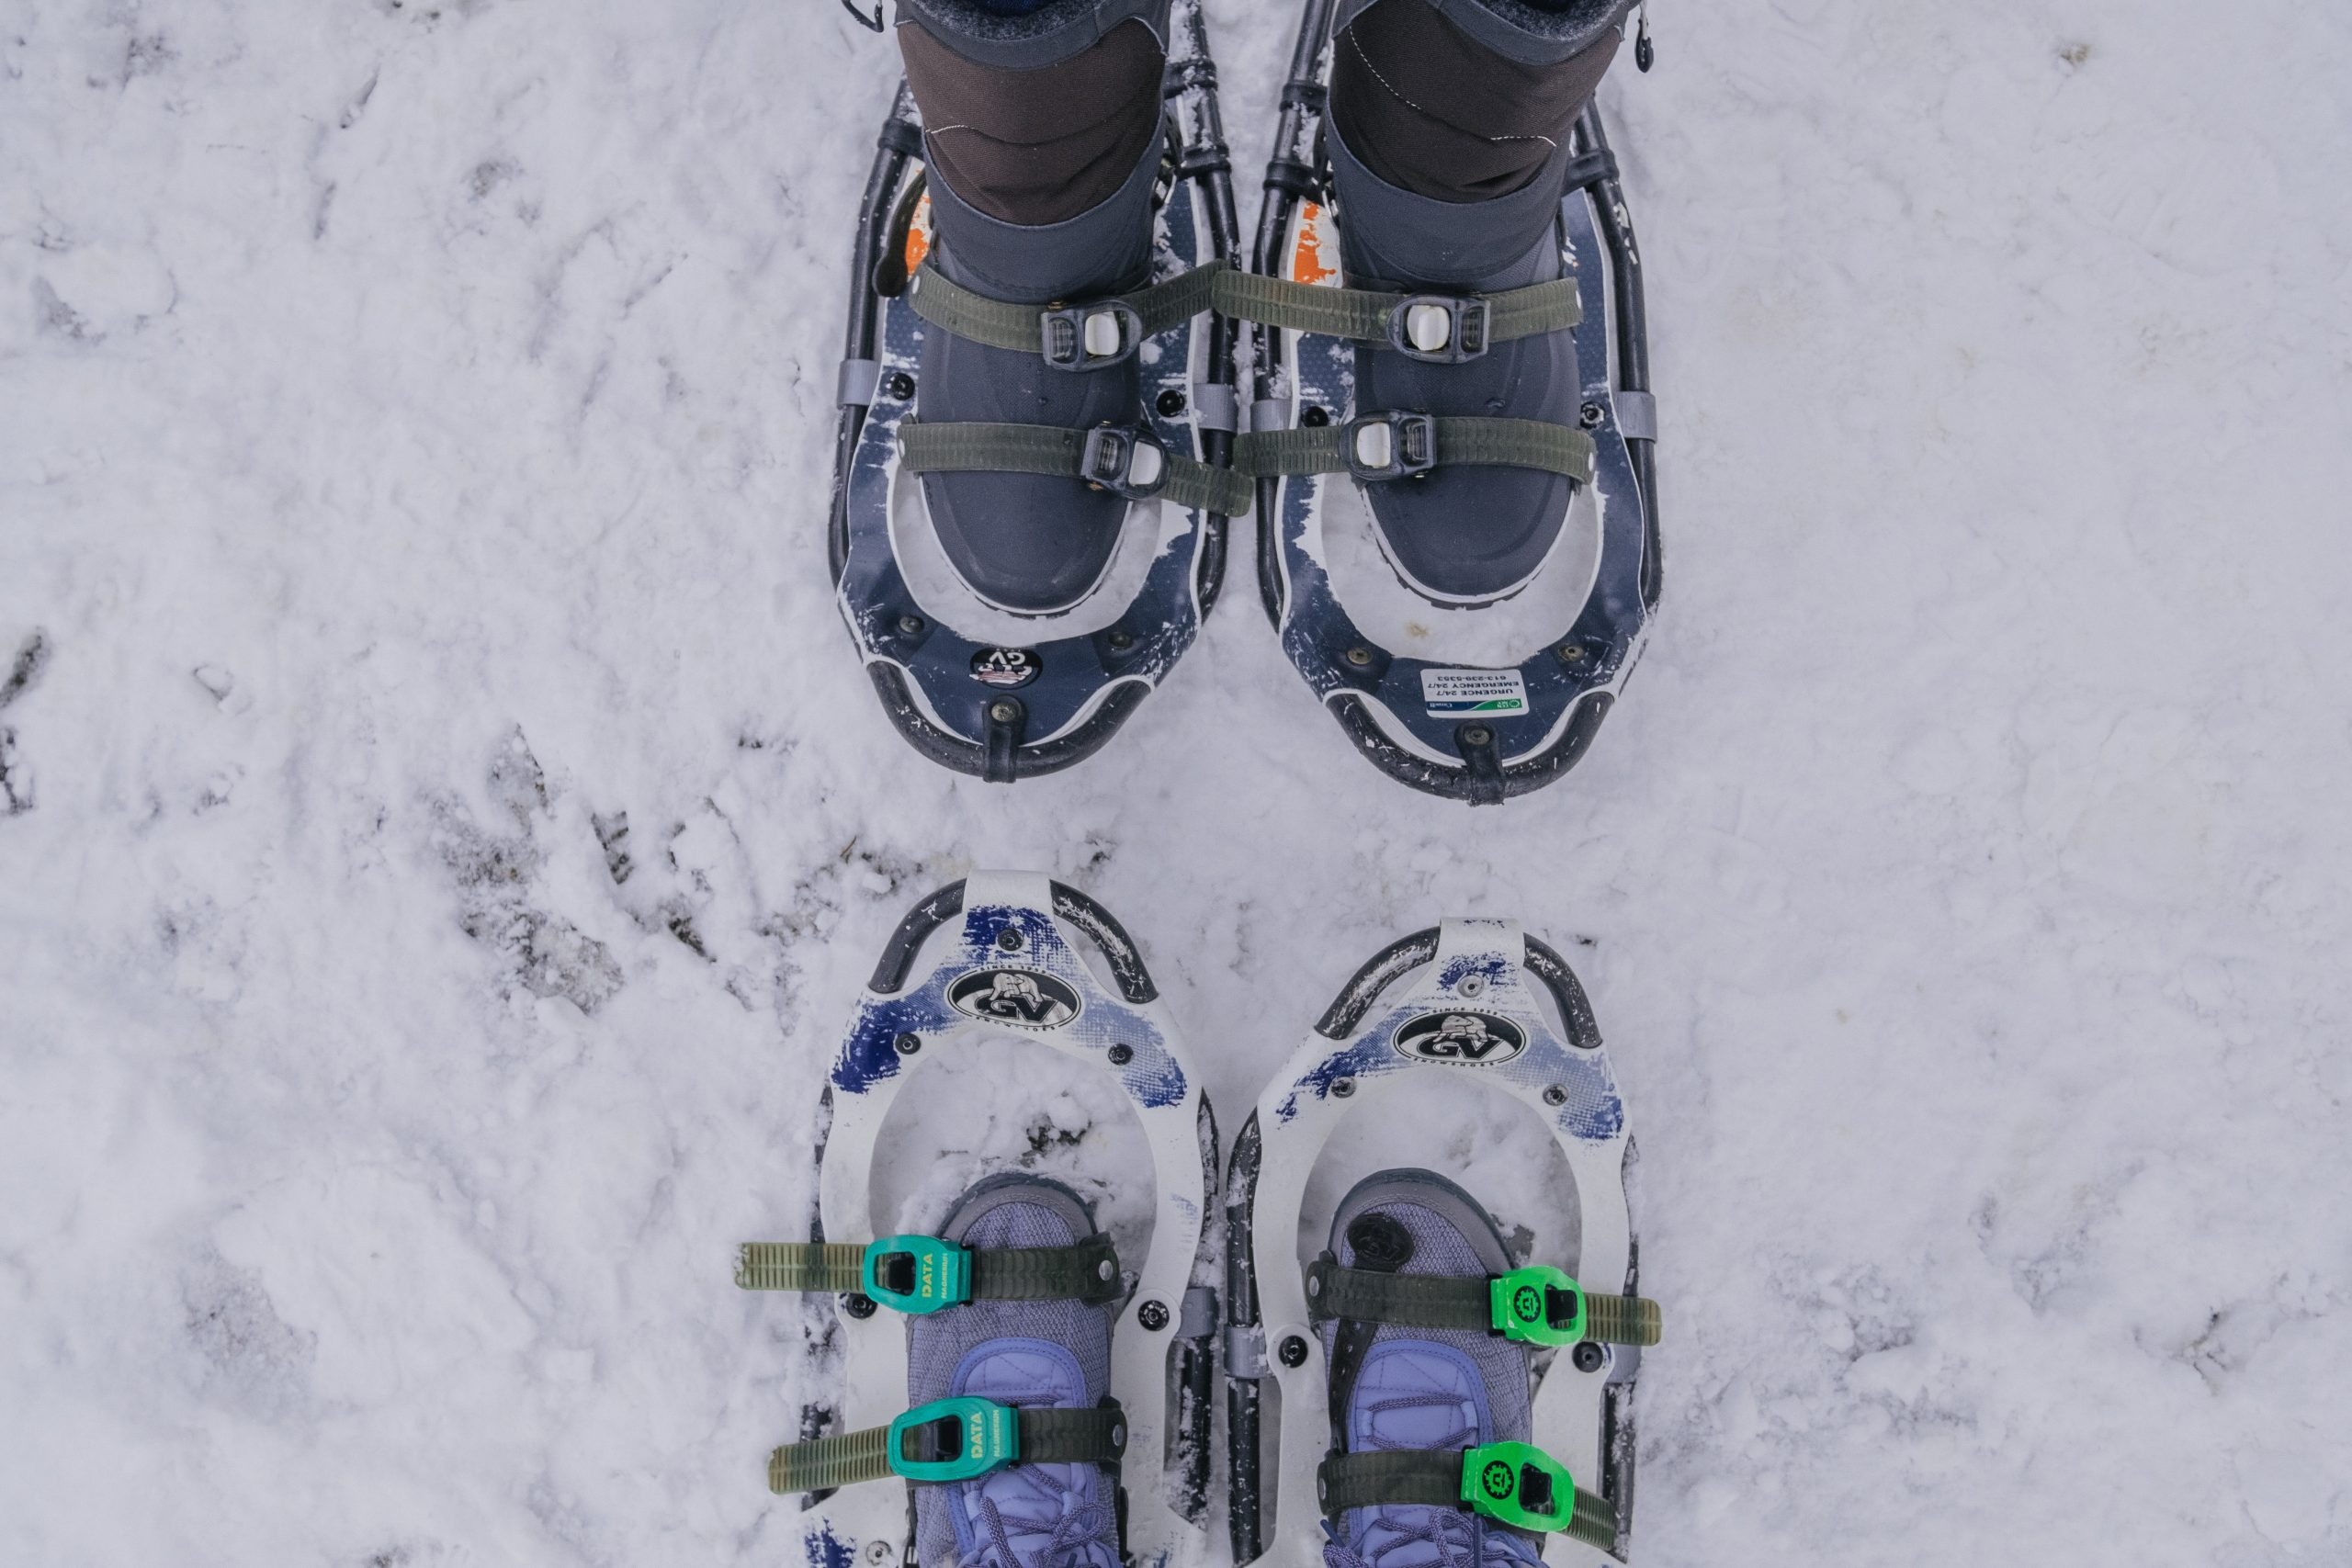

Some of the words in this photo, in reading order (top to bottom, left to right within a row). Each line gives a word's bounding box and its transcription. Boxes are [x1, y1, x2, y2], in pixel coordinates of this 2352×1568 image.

[989, 651, 1025, 665] GV
[974, 995, 1059, 1024] GV
[1416, 1035, 1505, 1061] GV
[922, 1252, 933, 1298] DATA
[970, 1411, 983, 1458] DATA
